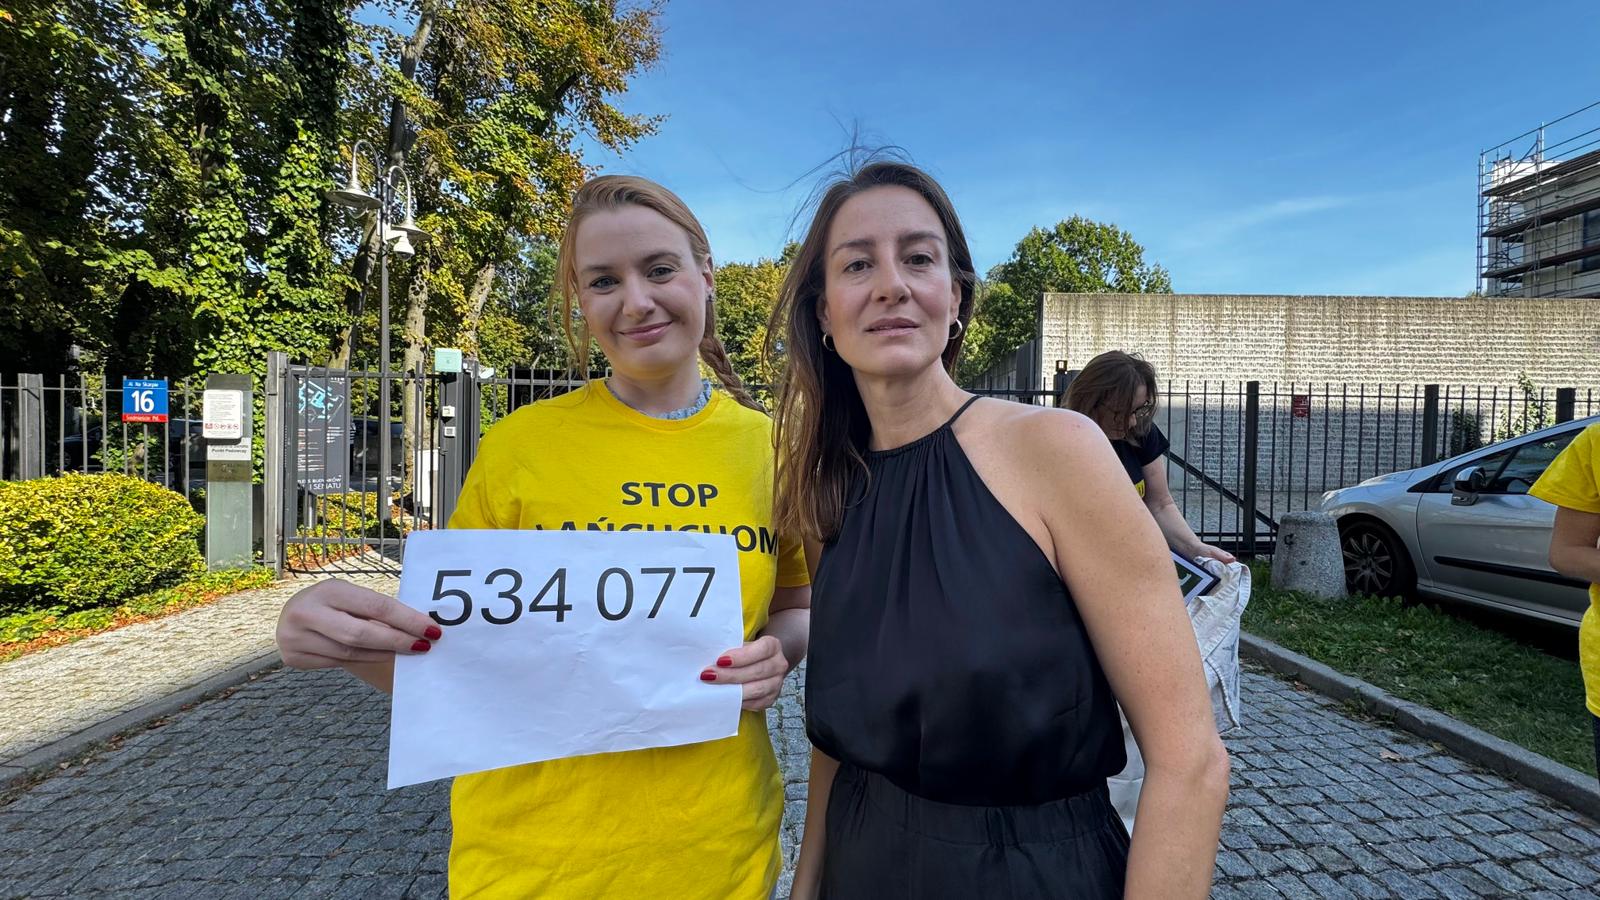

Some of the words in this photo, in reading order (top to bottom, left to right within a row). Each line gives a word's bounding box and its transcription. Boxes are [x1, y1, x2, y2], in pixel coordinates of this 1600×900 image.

[131, 390, 155, 413] 16
[621, 481, 719, 507] STOP
[428, 567, 573, 626] 534
[596, 566, 717, 621] 077
